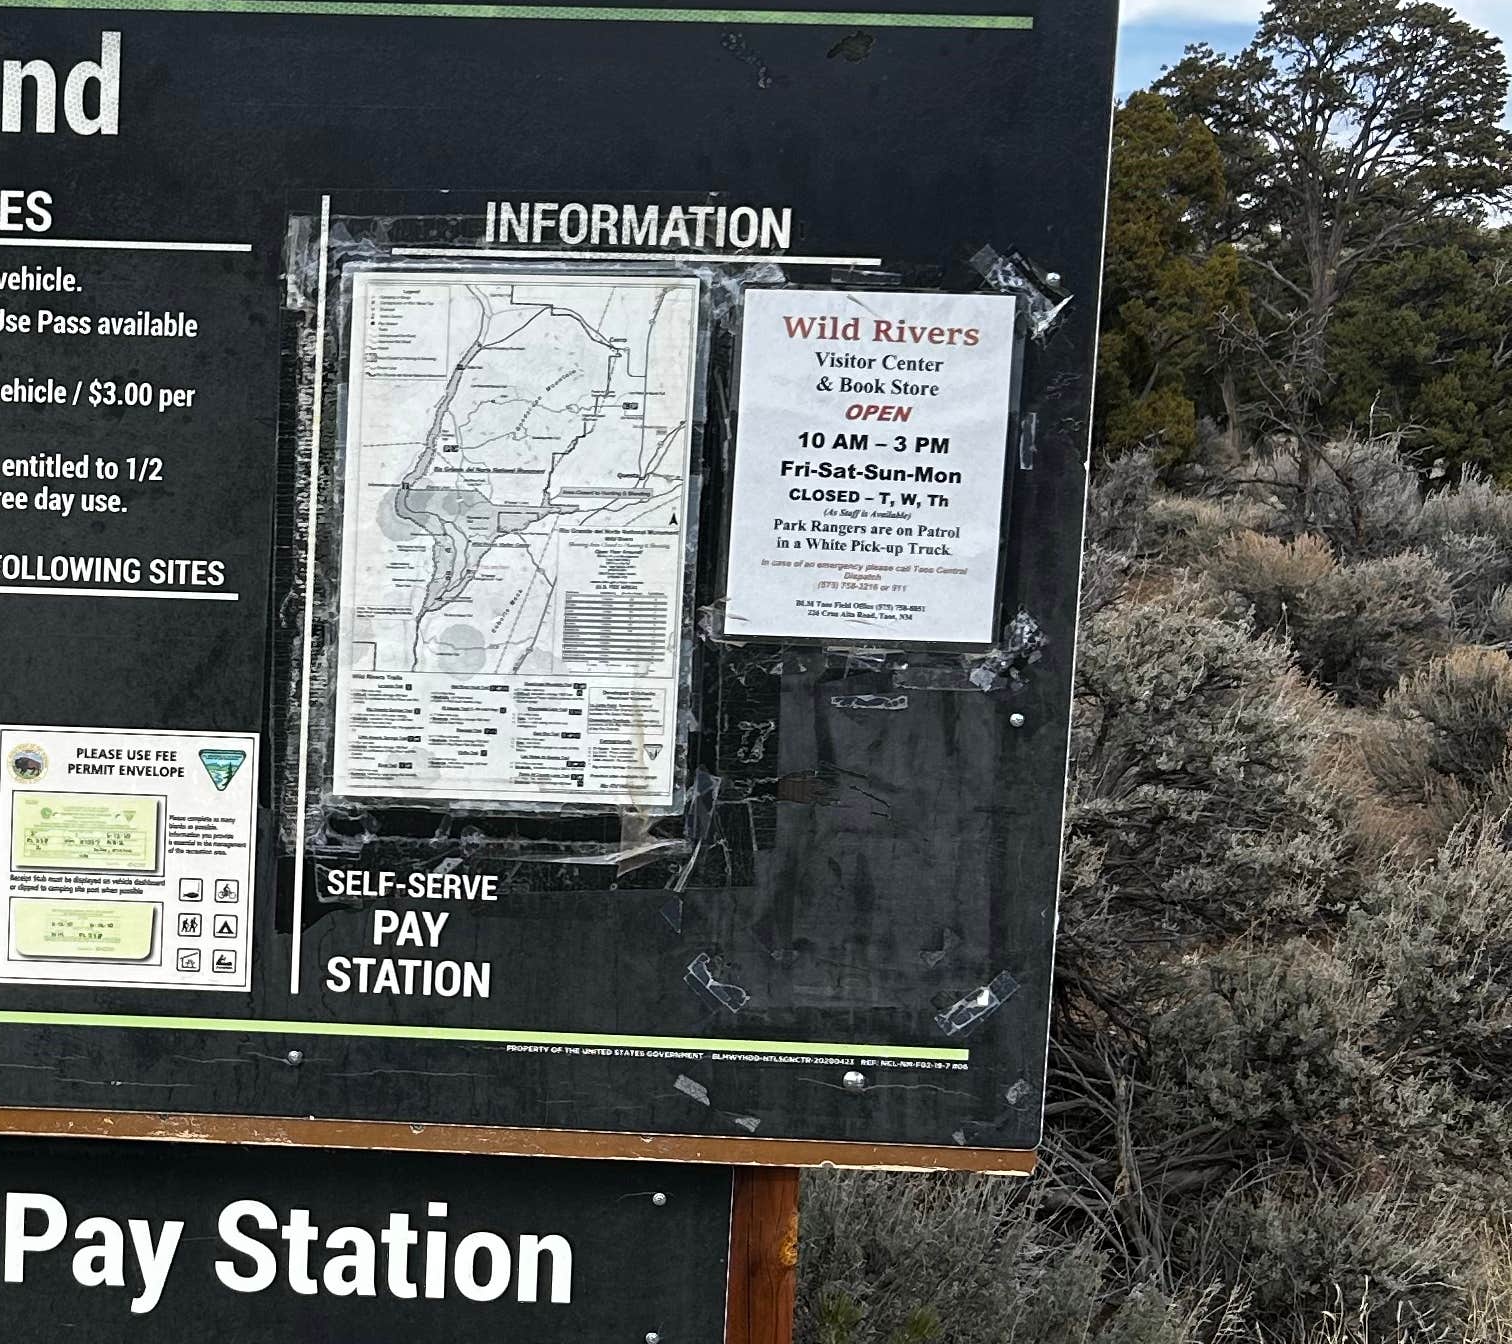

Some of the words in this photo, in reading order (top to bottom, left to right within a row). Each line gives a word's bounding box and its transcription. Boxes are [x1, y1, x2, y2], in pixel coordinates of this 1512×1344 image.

[485, 201, 792, 249] INFORMATION
[38, 310, 91, 334] Pass
[98, 311, 197, 337] available
[782, 316, 860, 341] Wild
[872, 319, 979, 346] Rivers
[815, 352, 877, 369] Visitor
[882, 354, 944, 372] Center
[816, 376, 833, 392] &
[839, 377, 885, 394] Book
[891, 379, 939, 396] Store
[845, 404, 913, 422] OPEN
[798, 432, 825, 449] 10
[832, 434, 869, 451] AM
[893, 436, 907, 452] 3
[915, 437, 950, 454] PM
[2, 453, 88, 478] entitled
[95, 458, 118, 479] to
[126, 458, 162, 482] 1/2
[781, 460, 961, 484] Fri-Sat-Sun-Mon
[789, 488, 860, 503] CLOSED
[879, 492, 895, 507] T,
[901, 493, 921, 509] W,
[927, 494, 949, 507] Th
[773, 518, 807, 531] Park
[810, 520, 866, 537] Rangers
[870, 526, 893, 535] are
[896, 527, 913, 536] on
[917, 525, 960, 538] Patrol
[776, 536, 789, 548] in
[793, 540, 802, 549] a
[805, 538, 847, 551] White
[850, 539, 903, 557] Pick-up
[149, 559, 225, 585] SITES
[77, 748, 123, 760] PLEASE
[127, 749, 151, 761] USE
[155, 750, 177, 762] FEE
[68, 763, 115, 775] PERMIT
[119, 765, 184, 778] ENVELOPE
[327, 869, 499, 901] SELF-SERVE
[374, 910, 449, 947] PAY
[326, 956, 490, 998] STATION
[4, 1192, 184, 1313] Pay
[215, 1200, 572, 1303] Station
